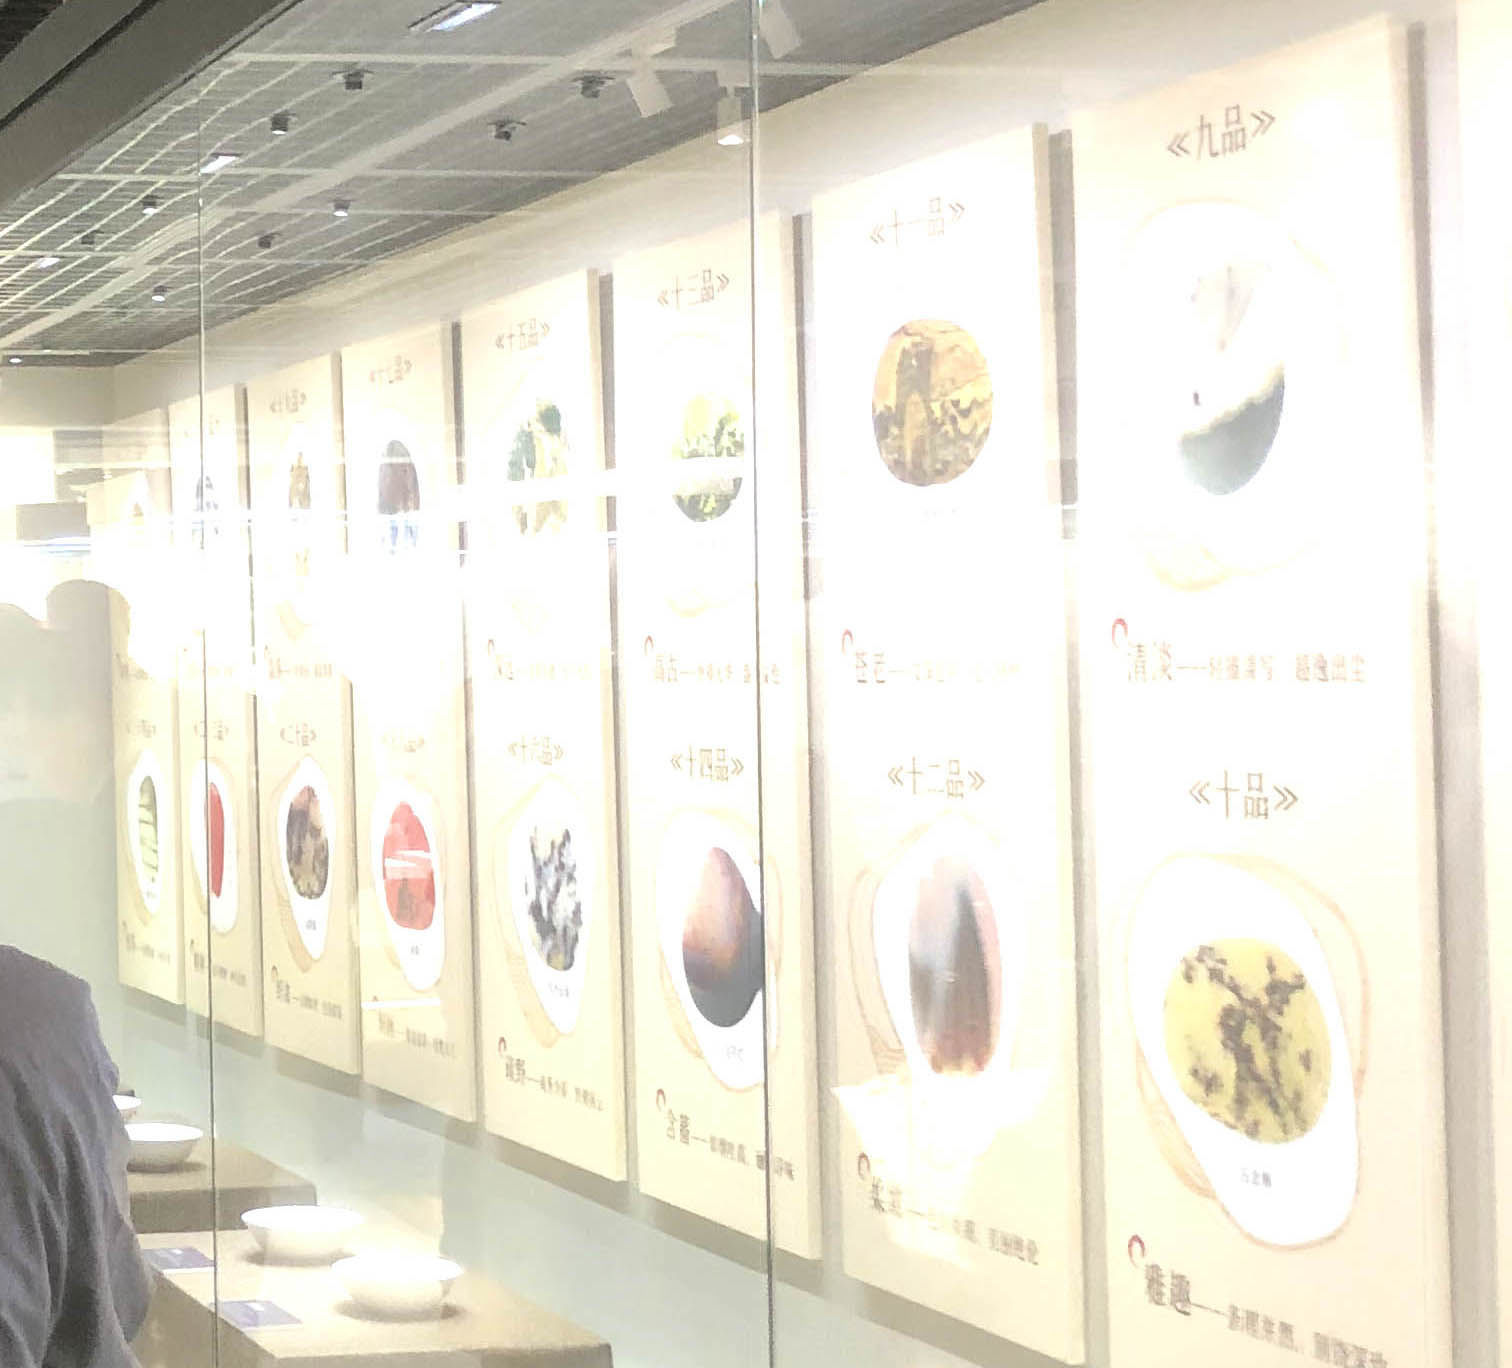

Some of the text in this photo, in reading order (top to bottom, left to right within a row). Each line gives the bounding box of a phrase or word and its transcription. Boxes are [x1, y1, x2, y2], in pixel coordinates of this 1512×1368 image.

[1166, 104, 1277, 160] 《九品》
[887, 755, 986, 800] 《十二品》
[1189, 769, 1299, 820] 《十品》
